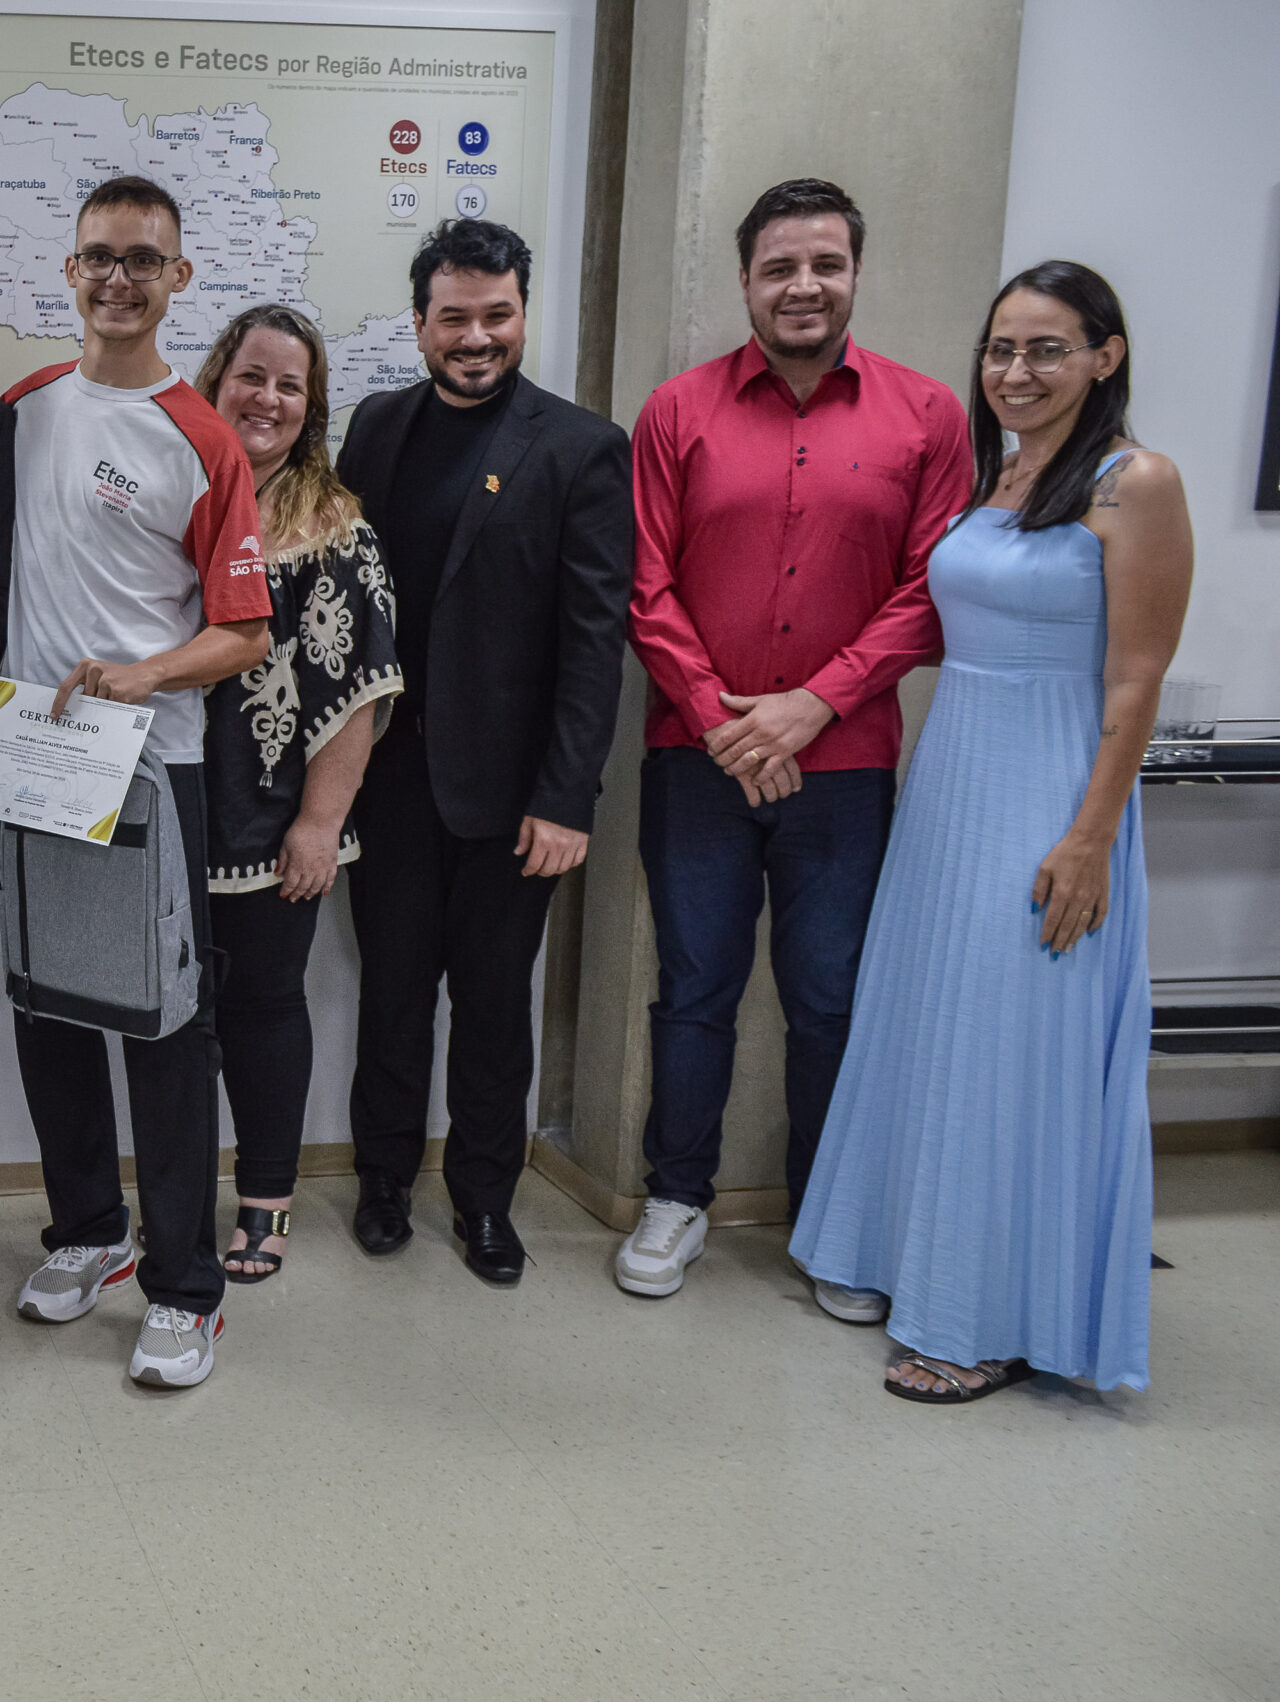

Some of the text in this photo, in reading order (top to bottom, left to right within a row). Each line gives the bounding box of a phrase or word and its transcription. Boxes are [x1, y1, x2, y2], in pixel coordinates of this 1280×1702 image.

[70, 41, 528, 80] Etecs e Fatecs por Região Administrativa
[156, 130, 200, 141] Barretos
[229, 135, 264, 146] Franca
[393, 131, 418, 145] 228
[465, 132, 482, 145] 83
[380, 158, 427, 174] Etecs
[446, 160, 497, 176] Fatecs
[76, 178, 96, 189] São
[251, 188, 321, 200] Ribeirão Preto
[391, 194, 416, 207] 170
[463, 197, 478, 209] 76
[199, 281, 248, 292] Campinas
[35, 300, 70, 311] Marília
[166, 341, 213, 351] Sorocaba
[377, 364, 419, 375] São José
[367, 375, 385, 385] dos
[93, 460, 139, 494] Etec
[230, 566, 250, 577] SÃO
[19, 709, 100, 734] CERTIFICADO
